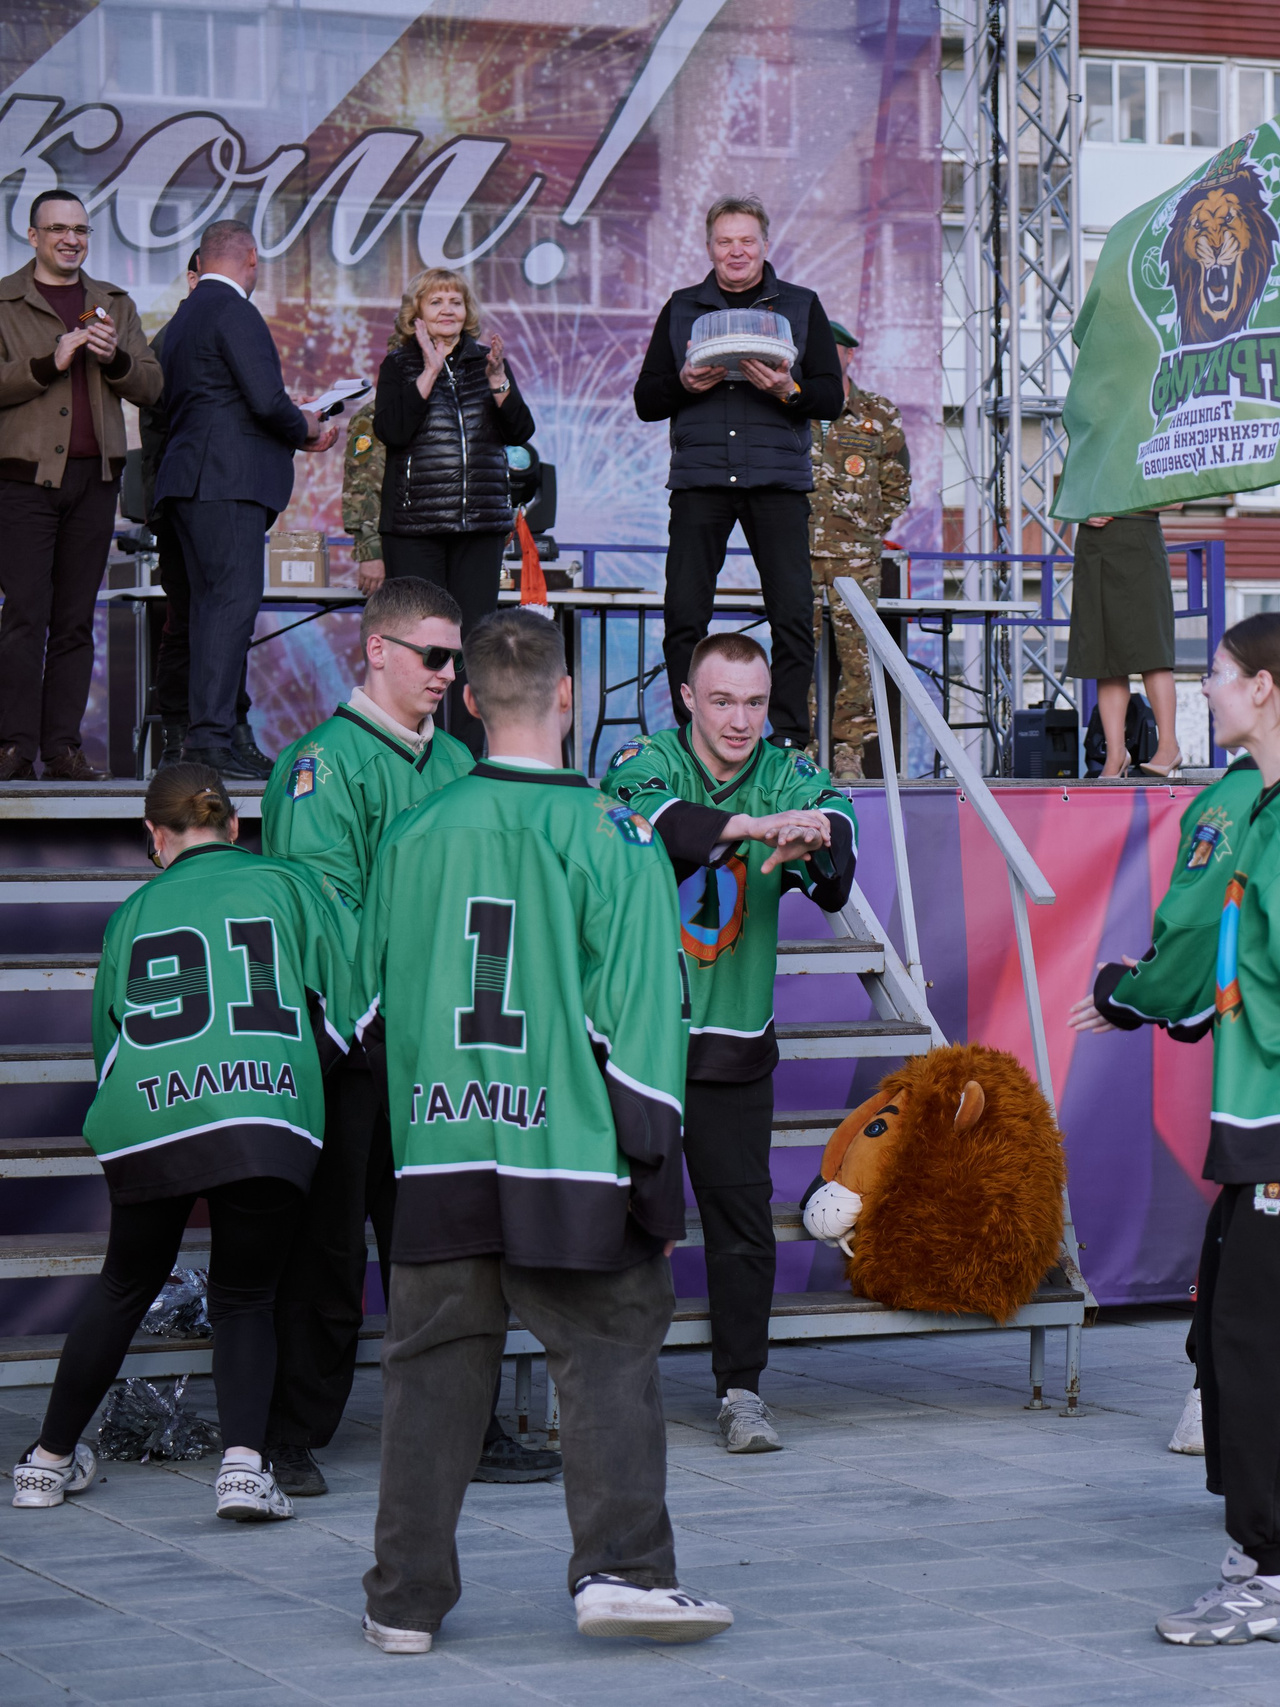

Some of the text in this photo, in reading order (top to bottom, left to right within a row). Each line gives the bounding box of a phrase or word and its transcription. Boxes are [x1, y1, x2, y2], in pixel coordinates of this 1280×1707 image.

[121, 915, 302, 1050] 91
[455, 896, 526, 1053] 1
[136, 1060, 298, 1112] ТАЛИЦА
